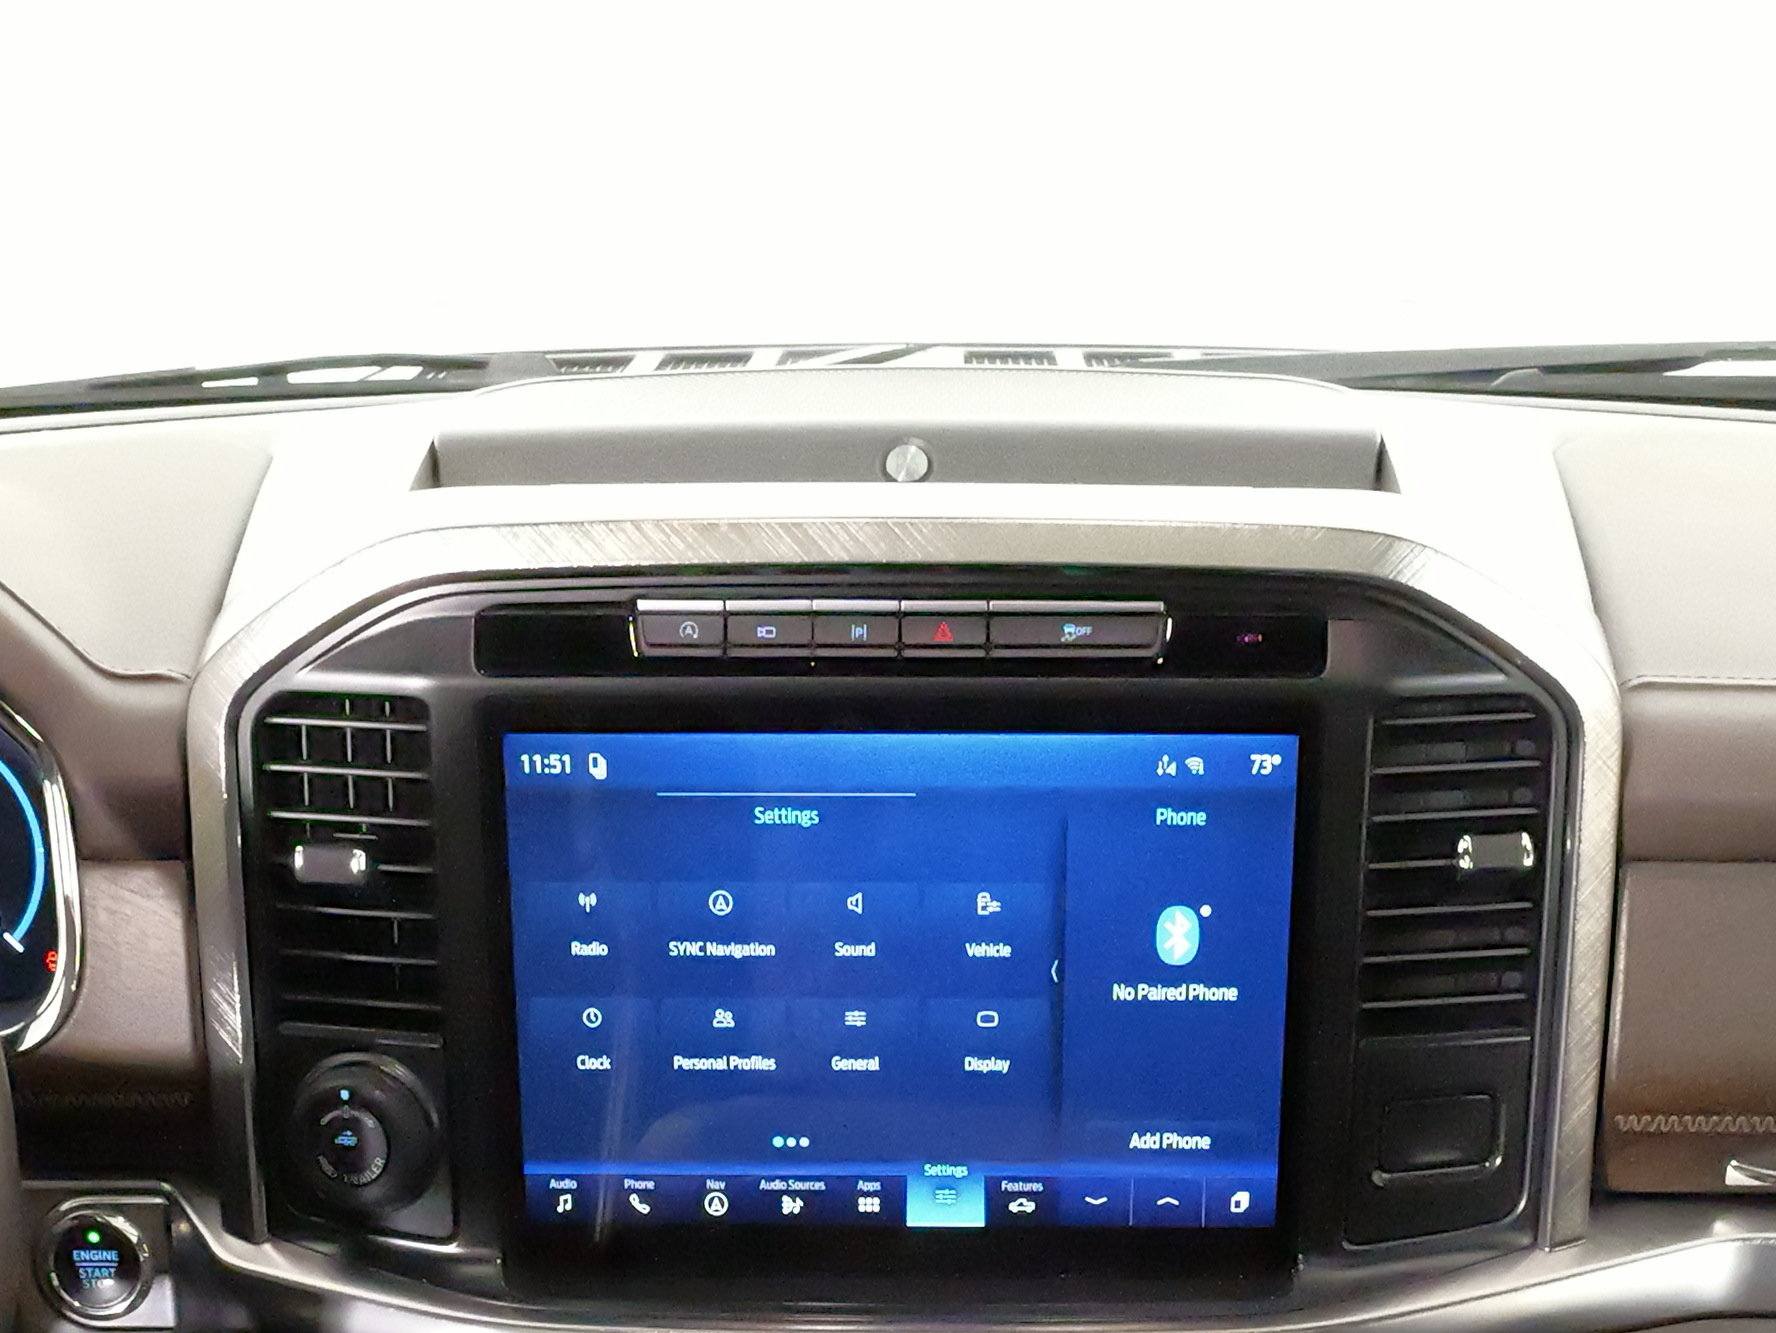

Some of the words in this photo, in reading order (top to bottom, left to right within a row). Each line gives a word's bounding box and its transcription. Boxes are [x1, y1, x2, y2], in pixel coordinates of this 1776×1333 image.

[520, 753, 572, 774] 11:51
[754, 806, 820, 828] Settings
[1155, 807, 1207, 827] Phone
[570, 940, 609, 957] Radio
[668, 941, 704, 957] SYNC
[706, 941, 776, 959] Navigation
[834, 941, 877, 957] Sound
[964, 941, 1012, 958] Vehicle
[1112, 983, 1136, 1001] No
[1137, 983, 1186, 1001] Paired
[1188, 983, 1239, 1001] Phone
[576, 1054, 612, 1071] Clock
[673, 1054, 728, 1071] Personal
[729, 1054, 777, 1071] Profiles
[830, 1055, 881, 1071] General
[963, 1055, 1011, 1075] Display
[1129, 1131, 1161, 1150] Add
[1162, 1131, 1212, 1150] Phone
[924, 1163, 969, 1178] Settings
[549, 1178, 578, 1190] Audio
[624, 1178, 655, 1190] Phone
[706, 1178, 726, 1190] Nav
[759, 1179, 787, 1191] Audio
[788, 1179, 826, 1191] Sources
[857, 1179, 881, 1192] Apps
[1001, 1180, 1044, 1193] Features
[72, 1249, 120, 1261] ENGINE
[79, 1267, 117, 1279] START
